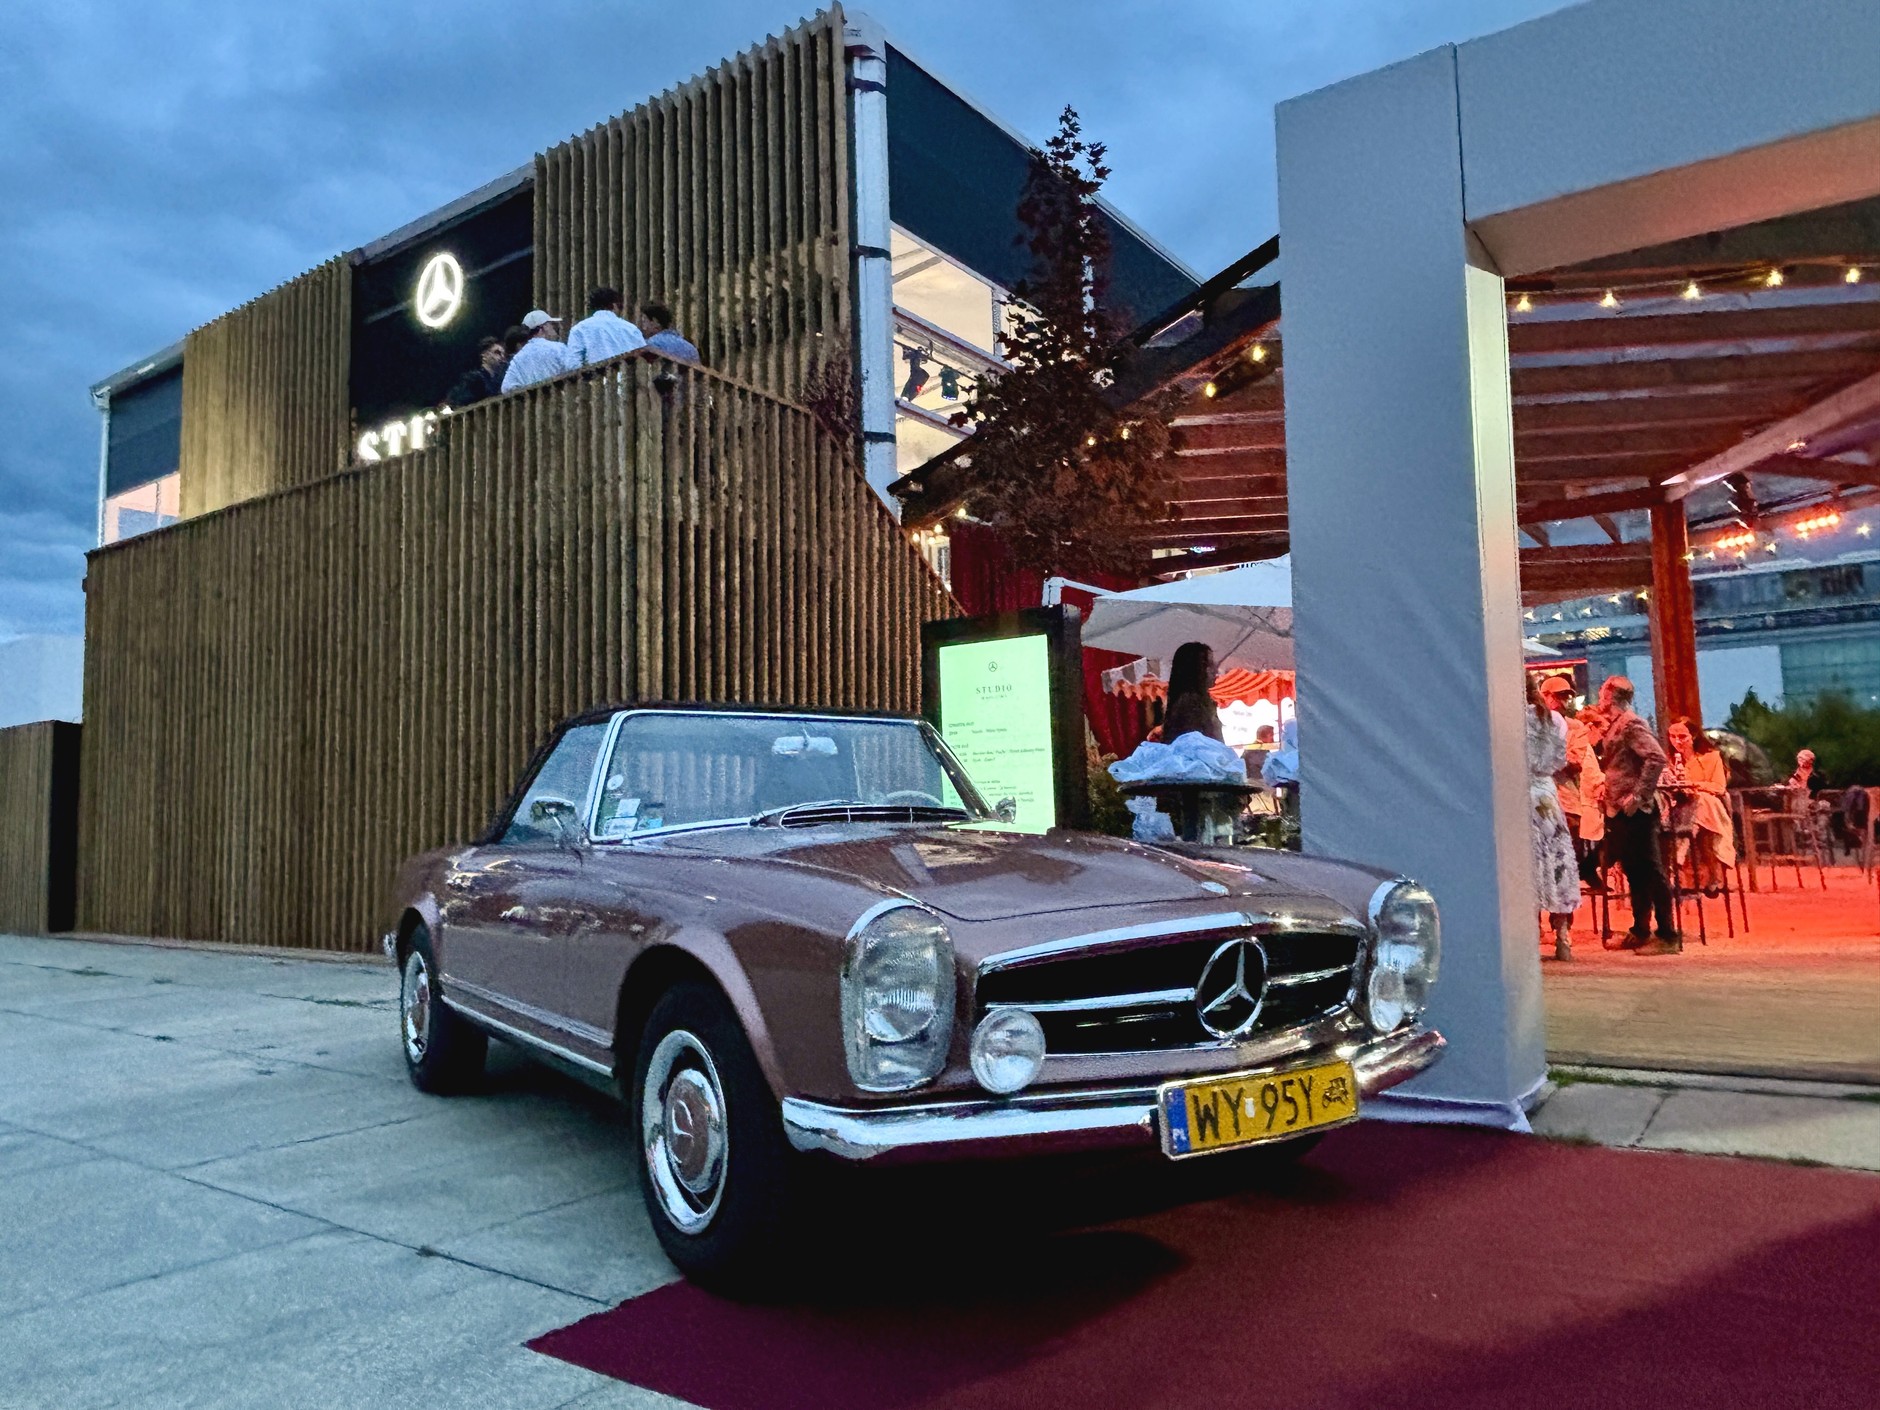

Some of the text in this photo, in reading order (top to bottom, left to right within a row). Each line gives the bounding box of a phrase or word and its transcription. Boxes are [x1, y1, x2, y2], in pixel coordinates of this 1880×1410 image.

[975, 683, 1013, 695] STUDIO
[1192, 1075, 1314, 1141] WY 95Y
